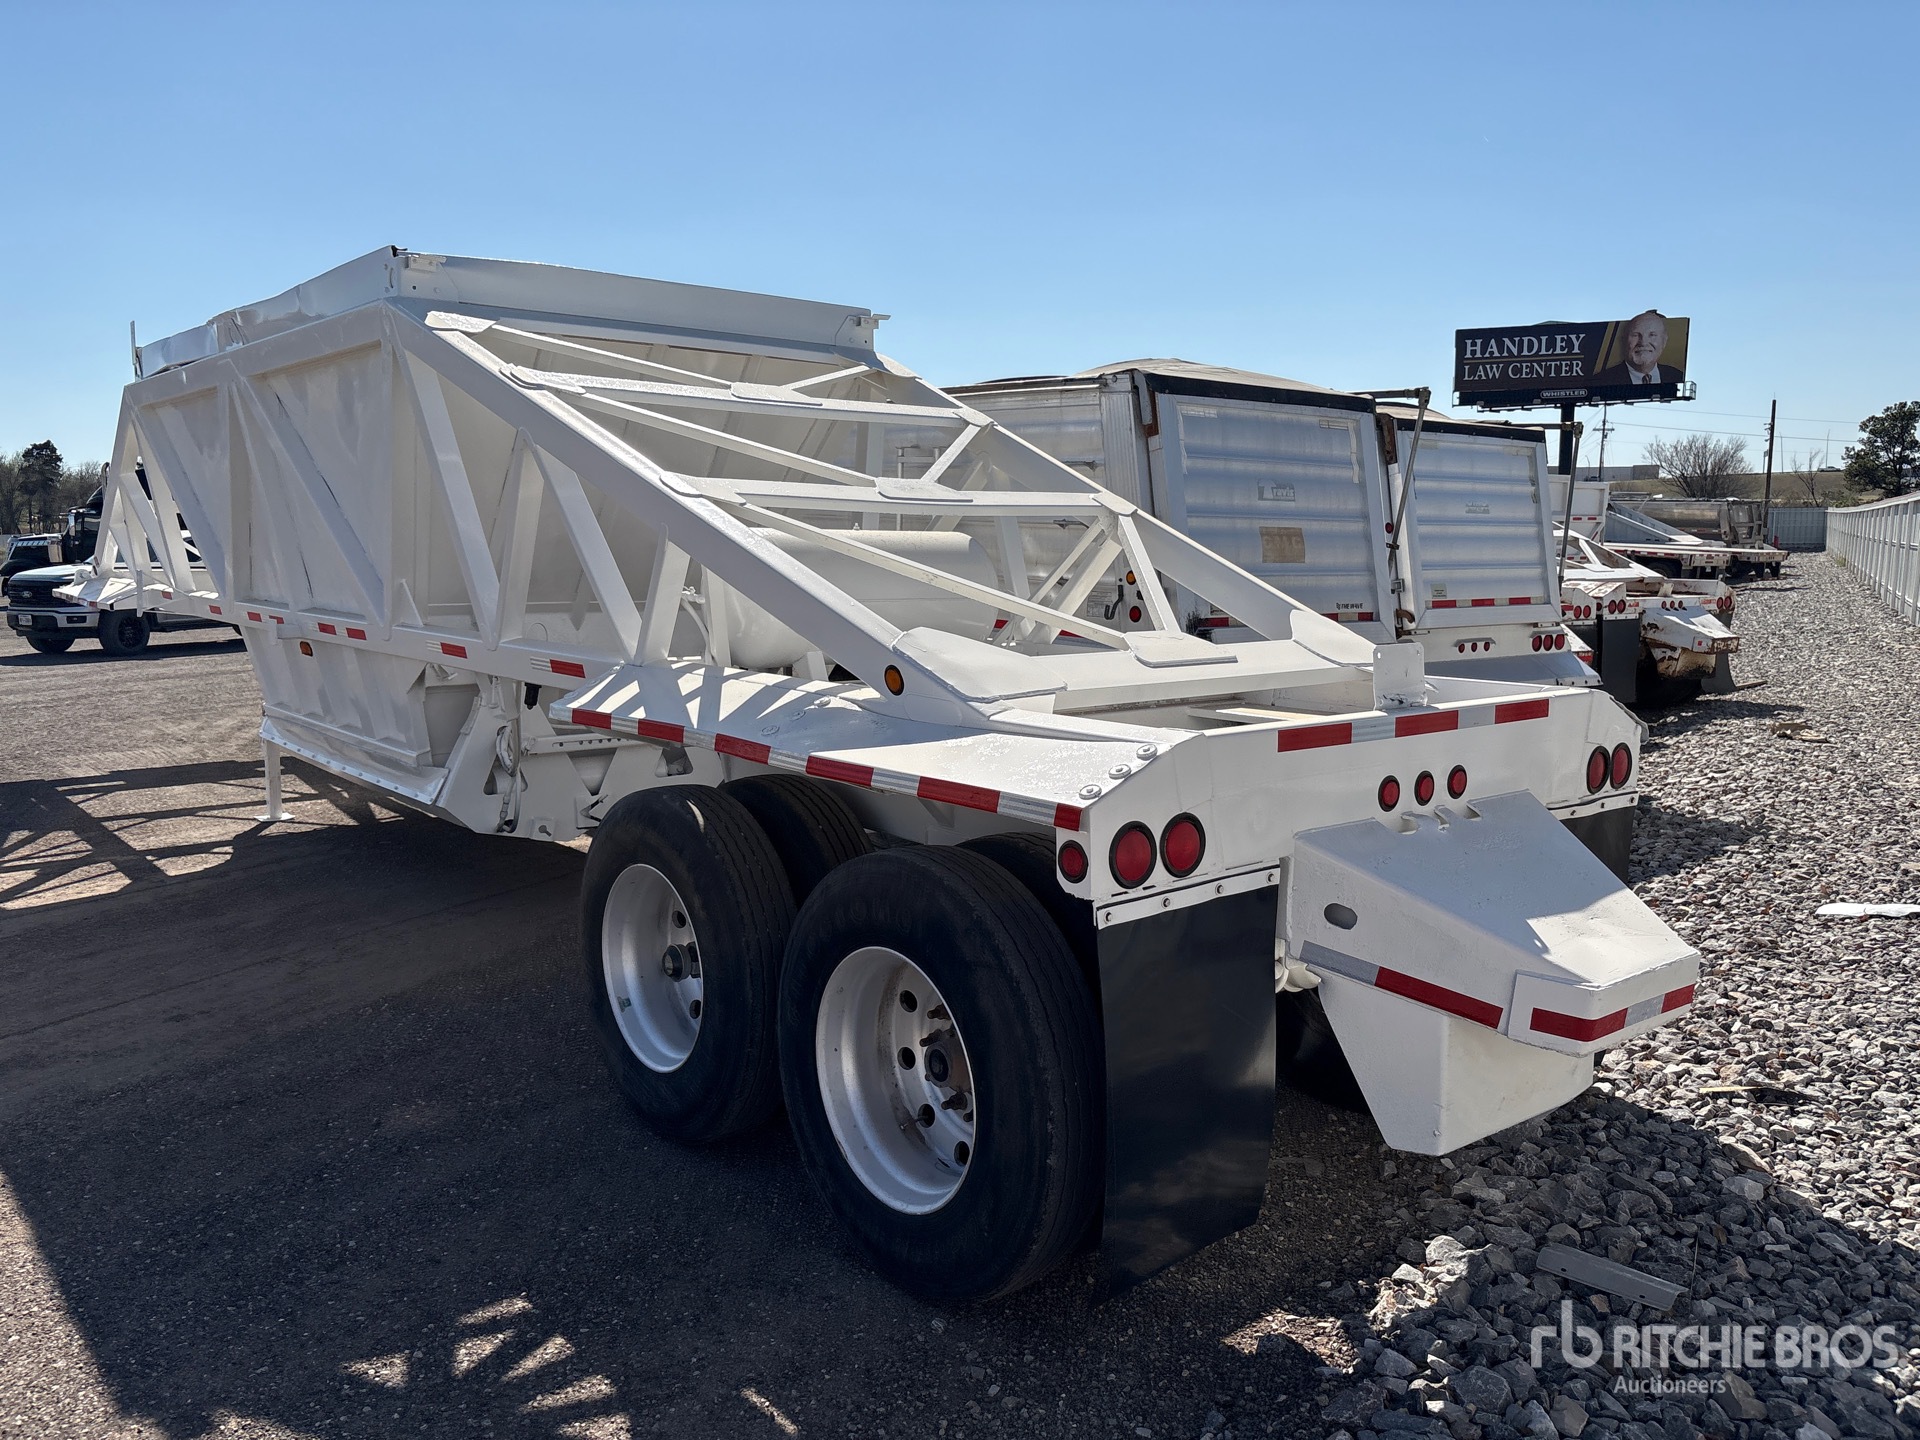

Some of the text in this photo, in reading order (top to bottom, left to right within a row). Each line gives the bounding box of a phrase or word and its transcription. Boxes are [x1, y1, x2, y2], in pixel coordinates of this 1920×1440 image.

[1464, 333, 1586, 358] HANDLEY
[1463, 360, 1585, 381] LAW CENTER
